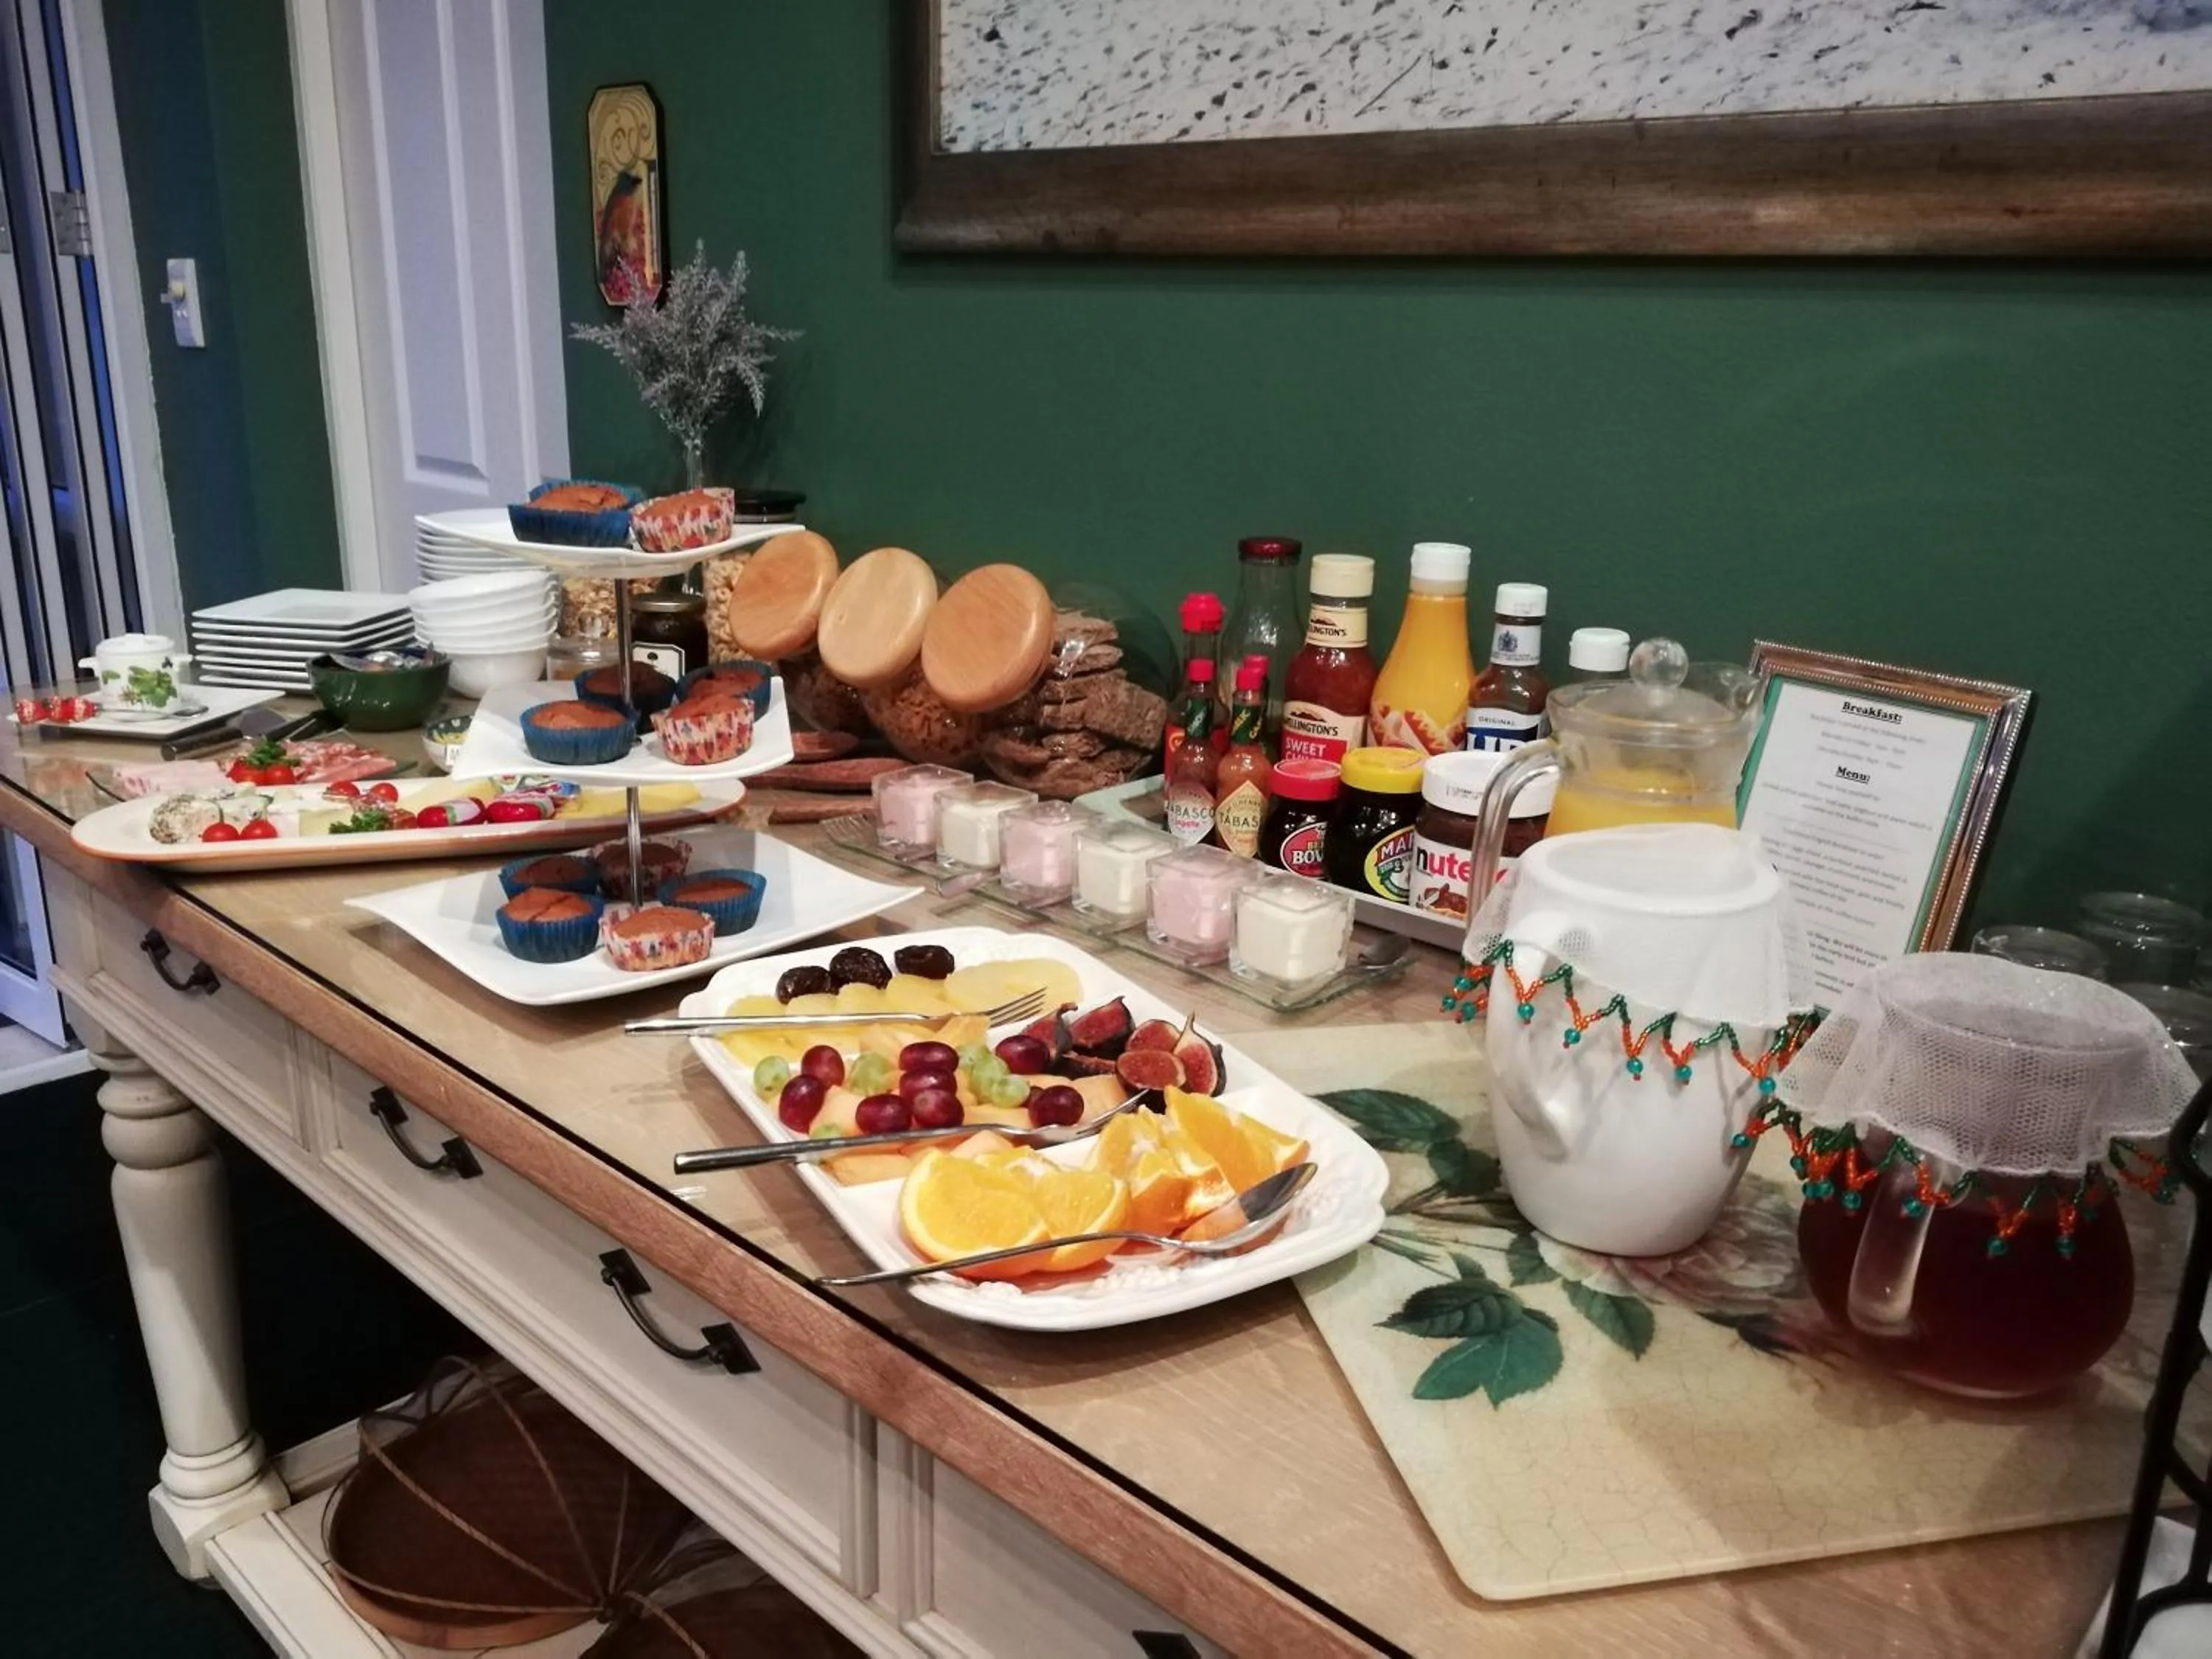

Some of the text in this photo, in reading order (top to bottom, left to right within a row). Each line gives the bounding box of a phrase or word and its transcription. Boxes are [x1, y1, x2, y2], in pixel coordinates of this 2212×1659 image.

[1841, 701, 1903, 723] Breakfast:
[1285, 737, 1326, 757] SWEET
[1836, 765, 1871, 784] Menu:
[1219, 812, 1259, 827] TABAS
[1292, 849, 1324, 865] BOV
[1416, 846, 1472, 884] nute
